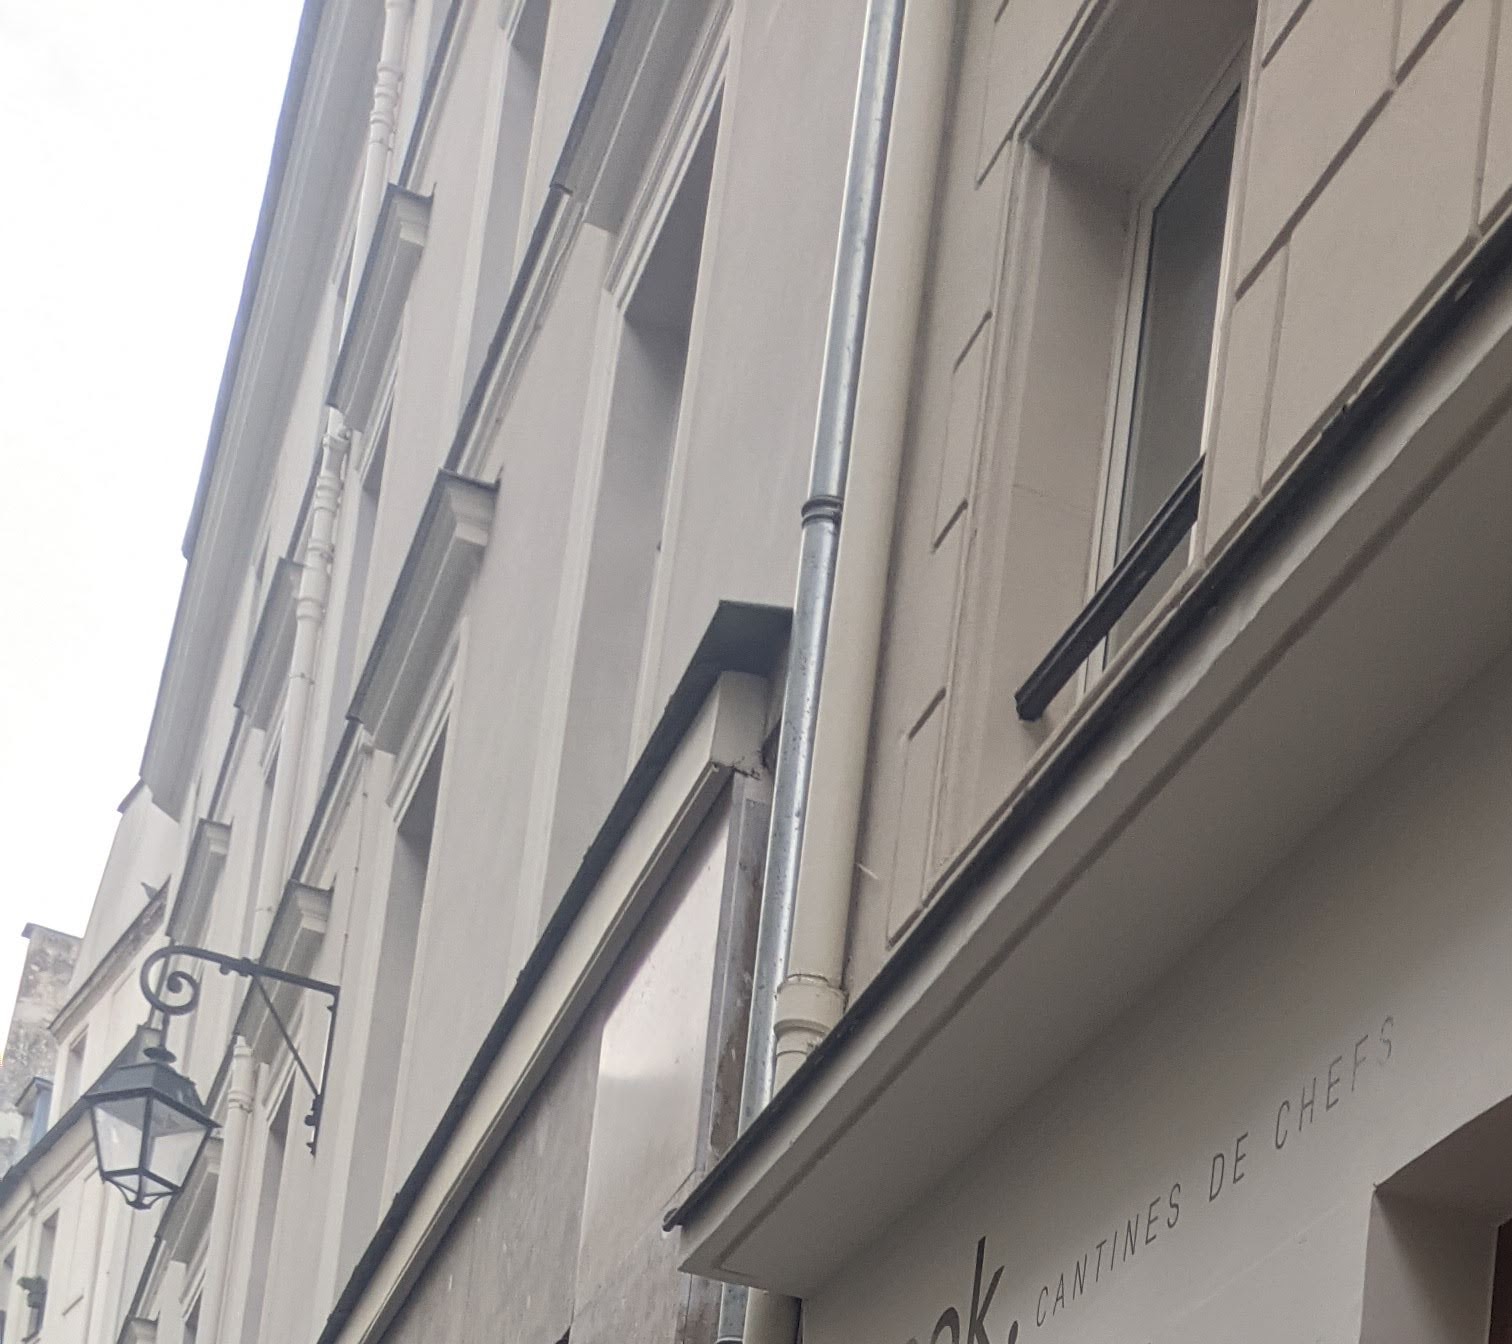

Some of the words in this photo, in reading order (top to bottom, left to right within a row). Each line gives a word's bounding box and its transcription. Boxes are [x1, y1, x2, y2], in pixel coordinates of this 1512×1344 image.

[1035, 1182, 1182, 1328] CANTINES
[1209, 1132, 1250, 1203] DE
[1274, 1014, 1395, 1150] CHEFS
